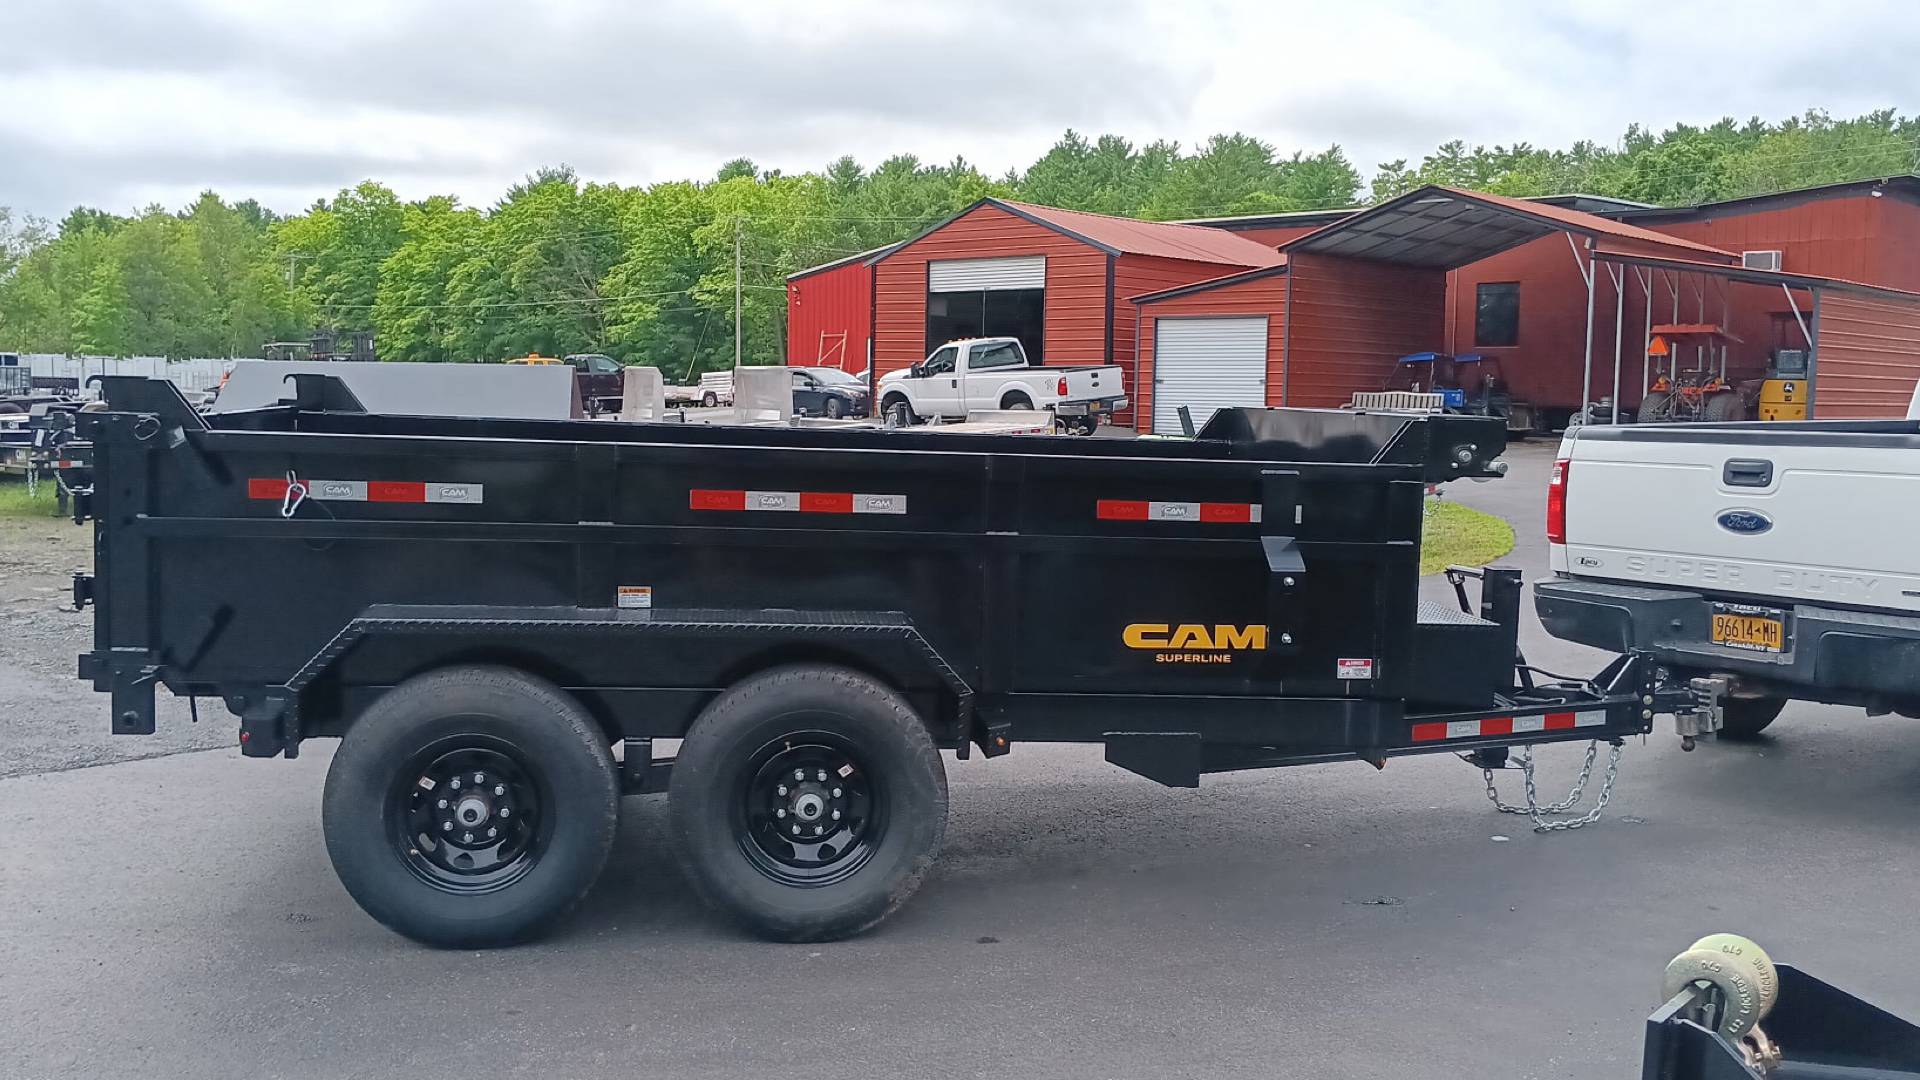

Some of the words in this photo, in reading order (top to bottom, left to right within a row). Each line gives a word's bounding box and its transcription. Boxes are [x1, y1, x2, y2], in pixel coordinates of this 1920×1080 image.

[325, 486, 350, 496] CAM
[441, 488, 466, 497] CAM
[761, 496, 784, 505] CAM
[868, 499, 890, 508] CAM
[1164, 507, 1186, 515] CAM
[1727, 514, 1758, 529] Ford
[1626, 557, 1746, 586] SUPER
[1773, 570, 1880, 599] DUTY
[1122, 623, 1266, 649] CAM
[1155, 654, 1231, 663] SUPERLINE
